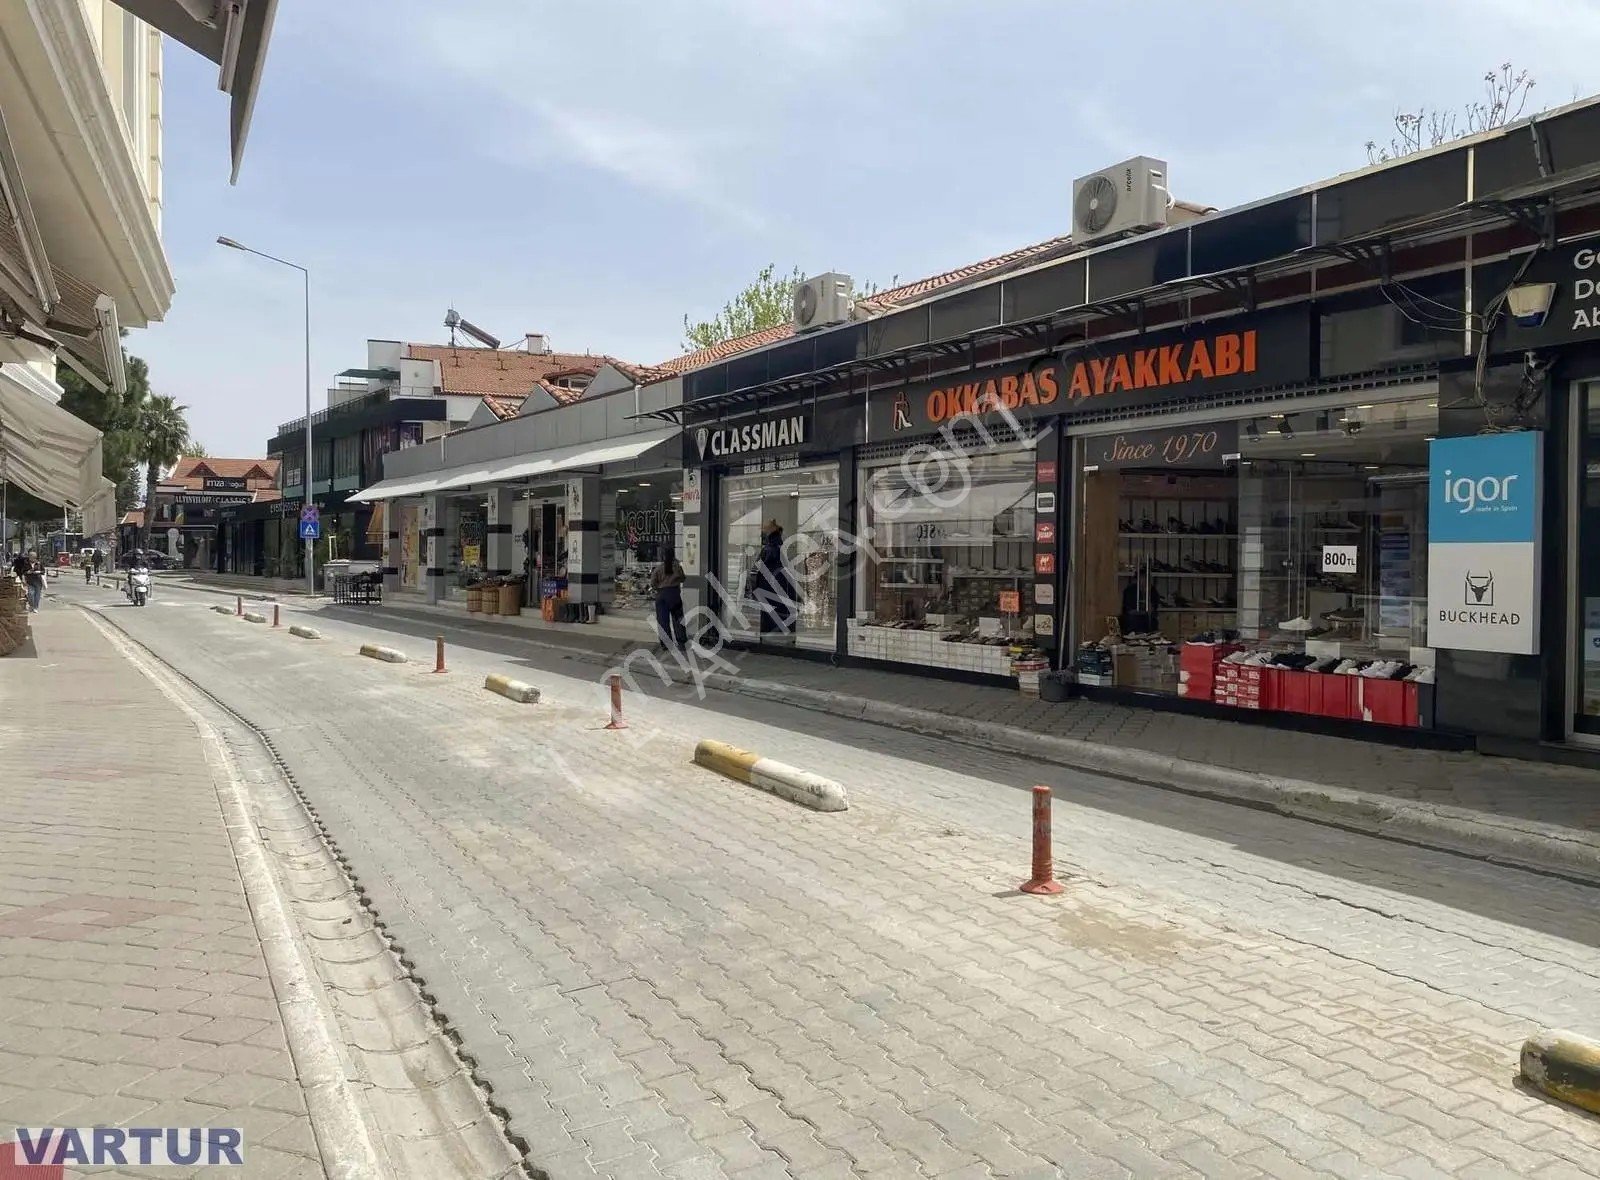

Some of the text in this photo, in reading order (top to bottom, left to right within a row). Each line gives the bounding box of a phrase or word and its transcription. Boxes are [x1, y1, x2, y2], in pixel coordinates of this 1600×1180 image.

[1573, 248, 1600, 270] G
[1574, 278, 1600, 300] D
[926, 330, 1257, 422] OKKABAS AYAKKABI
[711, 416, 804, 456] CLASSMAN
[1103, 431, 1218, 463] Since 1970
[1445, 470, 1519, 513] igor
[1439, 610, 1520, 626] BUCKHEAD
